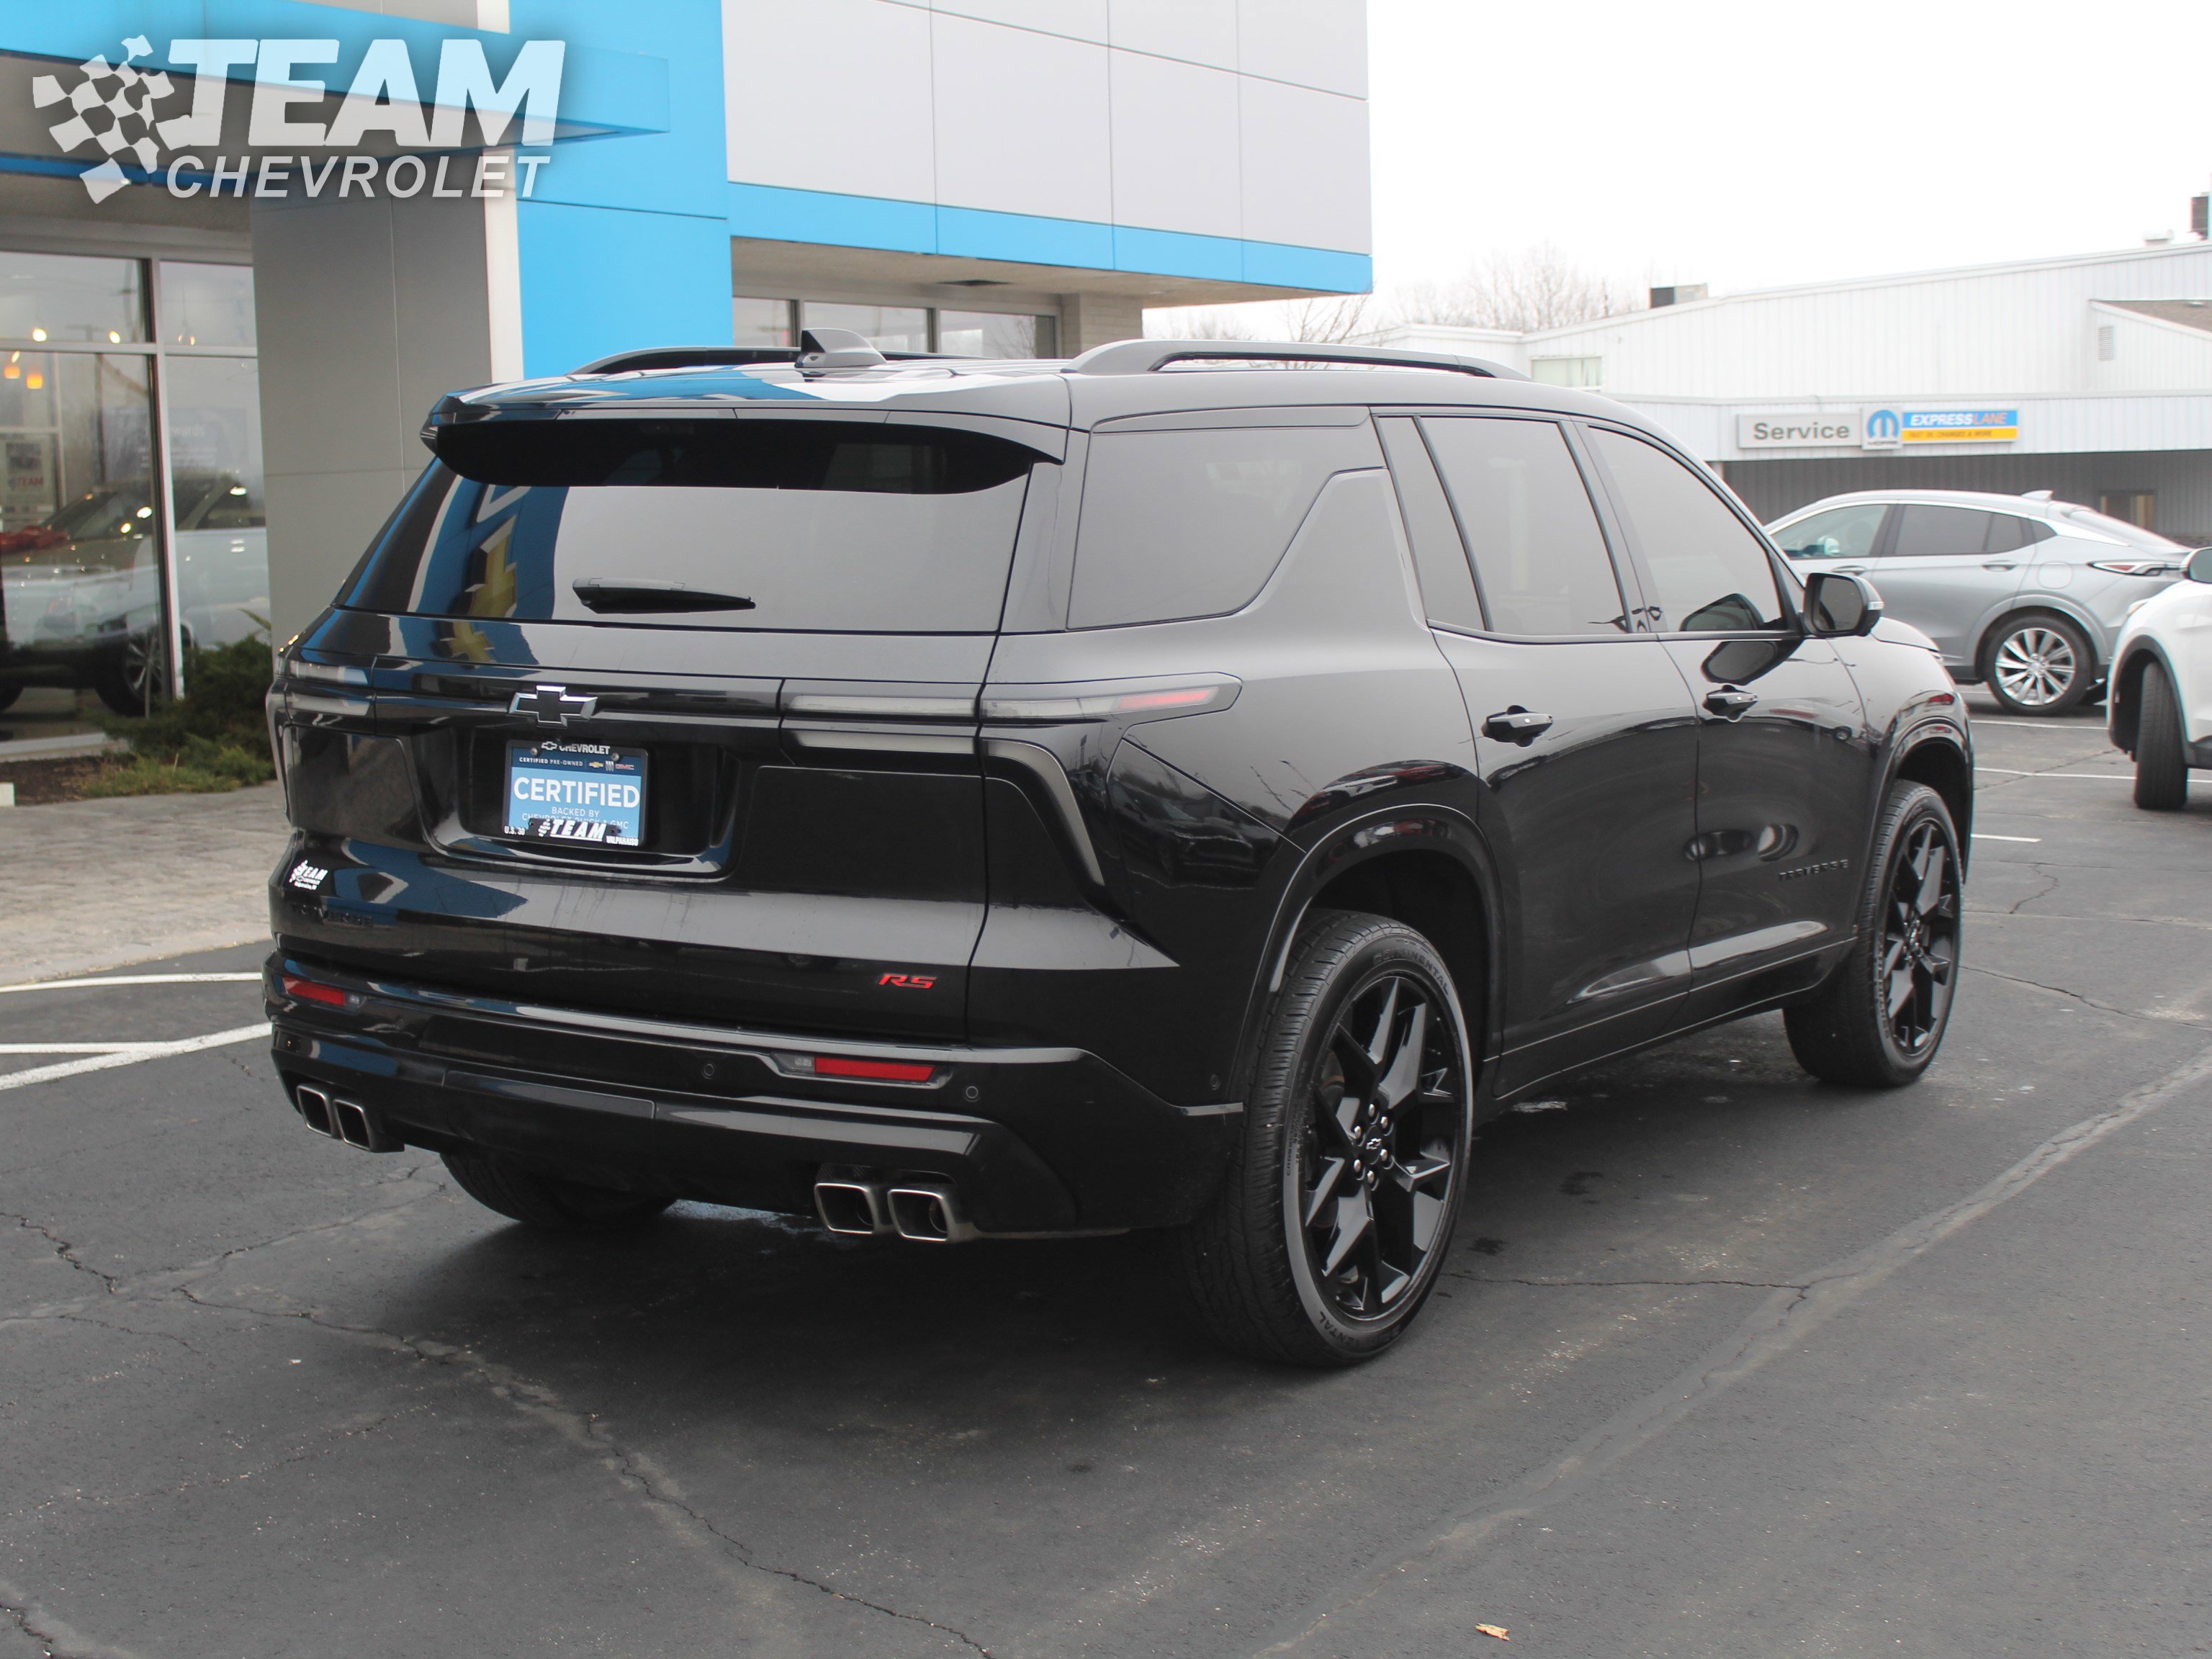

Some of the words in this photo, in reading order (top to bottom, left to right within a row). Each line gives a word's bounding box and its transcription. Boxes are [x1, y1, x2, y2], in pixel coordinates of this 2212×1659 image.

[1753, 422, 1849, 440] Service
[513, 777, 640, 808] CERTIFIED
[552, 806, 585, 817] BACKED
[589, 809, 600, 818] BY
[550, 819, 607, 840] TEAM
[878, 973, 938, 989] RS
